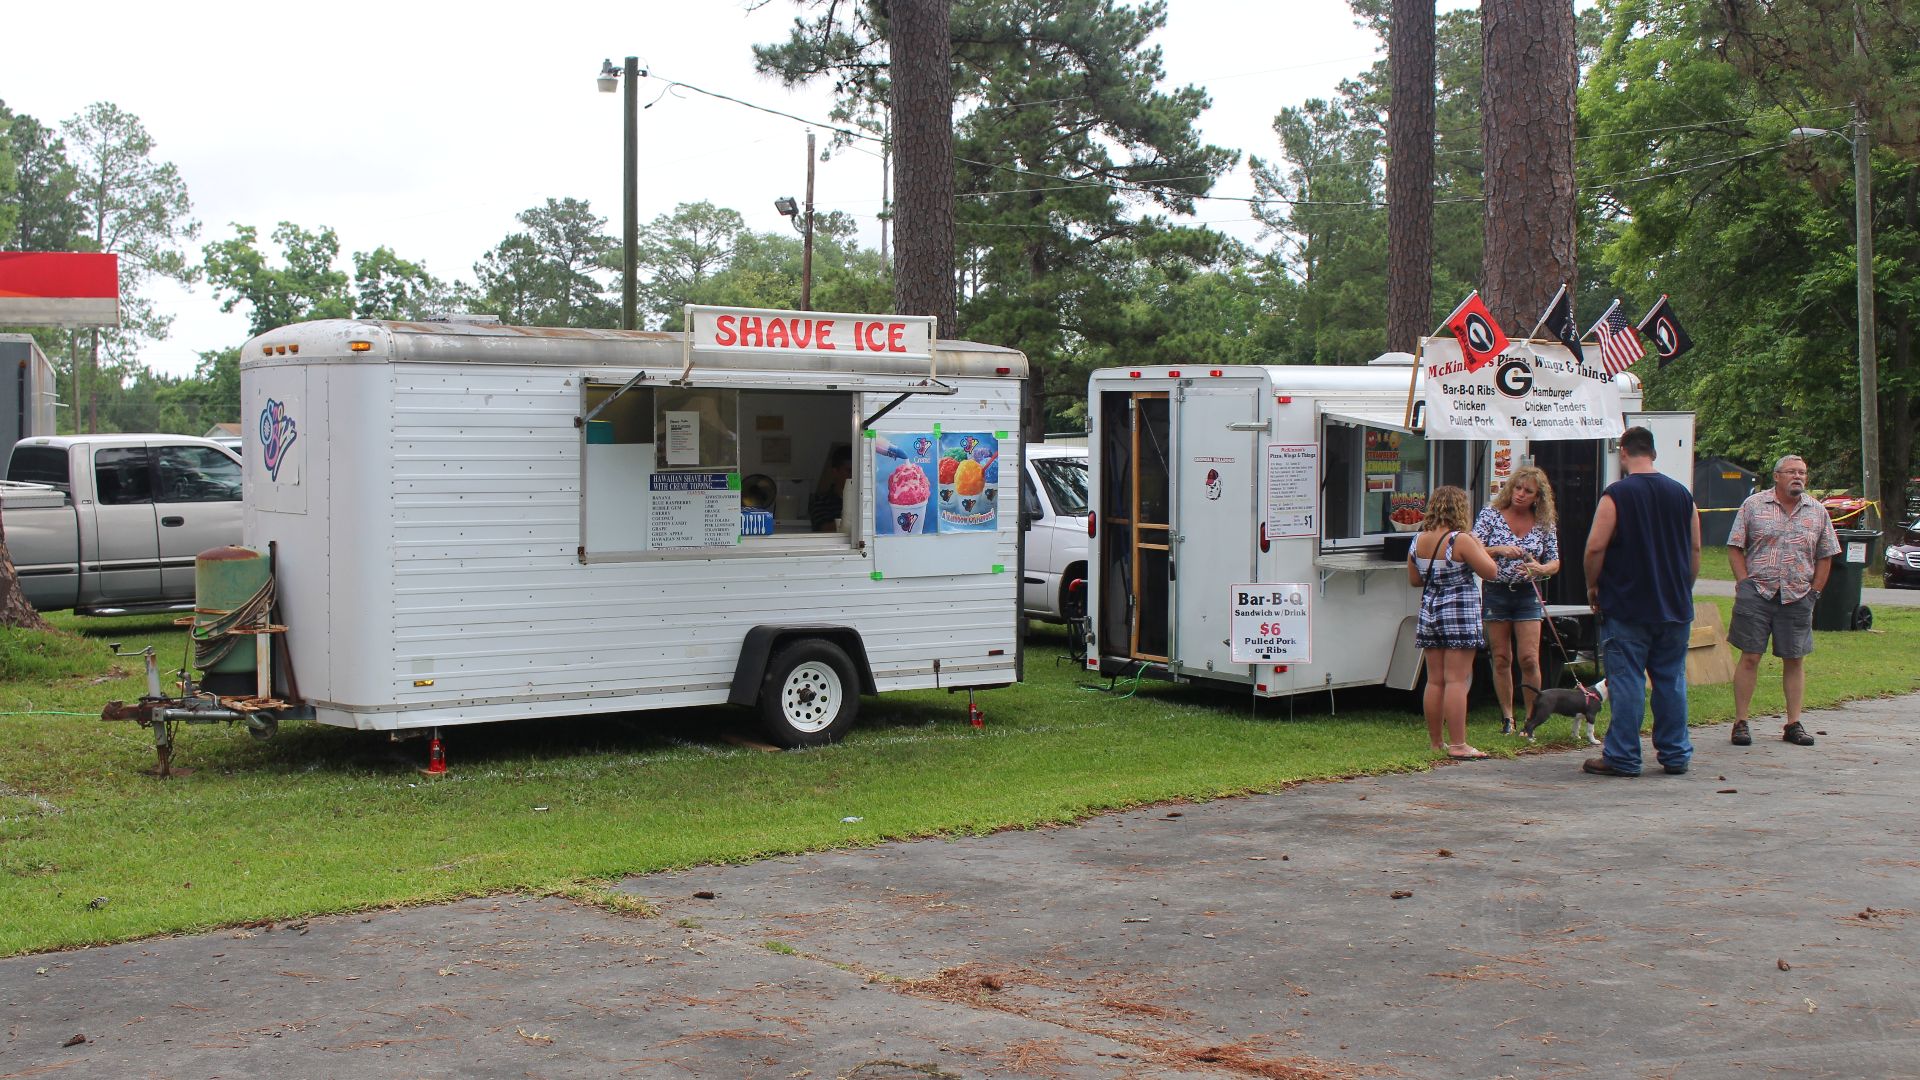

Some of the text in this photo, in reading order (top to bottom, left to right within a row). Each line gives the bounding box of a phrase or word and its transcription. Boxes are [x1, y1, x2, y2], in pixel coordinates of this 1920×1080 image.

[715, 315, 907, 352] SHAVE ICE
[1535, 355, 1564, 374] Wingz
[1566, 360, 1574, 373] &
[1575, 362, 1615, 384] Thingz
[1495, 360, 1534, 398] G
[1442, 384, 1496, 396] Bar-B-Q Ribs
[1532, 386, 1573, 400] Hamburger
[1453, 400, 1486, 411] Chicken
[1525, 402, 1587, 412] Chicken Tenders
[1449, 415, 1495, 426] Pulled Pork
[1511, 417, 1527, 427] Tea
[1533, 416, 1574, 427] Lemonade
[1580, 416, 1603, 426] Water
[653, 474, 712, 482] HAWAIIAN SHAVE ICE
[653, 482, 669, 490] WITH
[690, 482, 713, 490] TOPPING
[1304, 515, 1312, 529] $1
[1238, 592, 1303, 606] Bar-B-Q
[1235, 609, 1306, 617] Sandwich w/Drink
[1260, 622, 1281, 637] $6
[1244, 637, 1297, 645] Pulled Pork
[1266, 646, 1287, 654] Ribs
